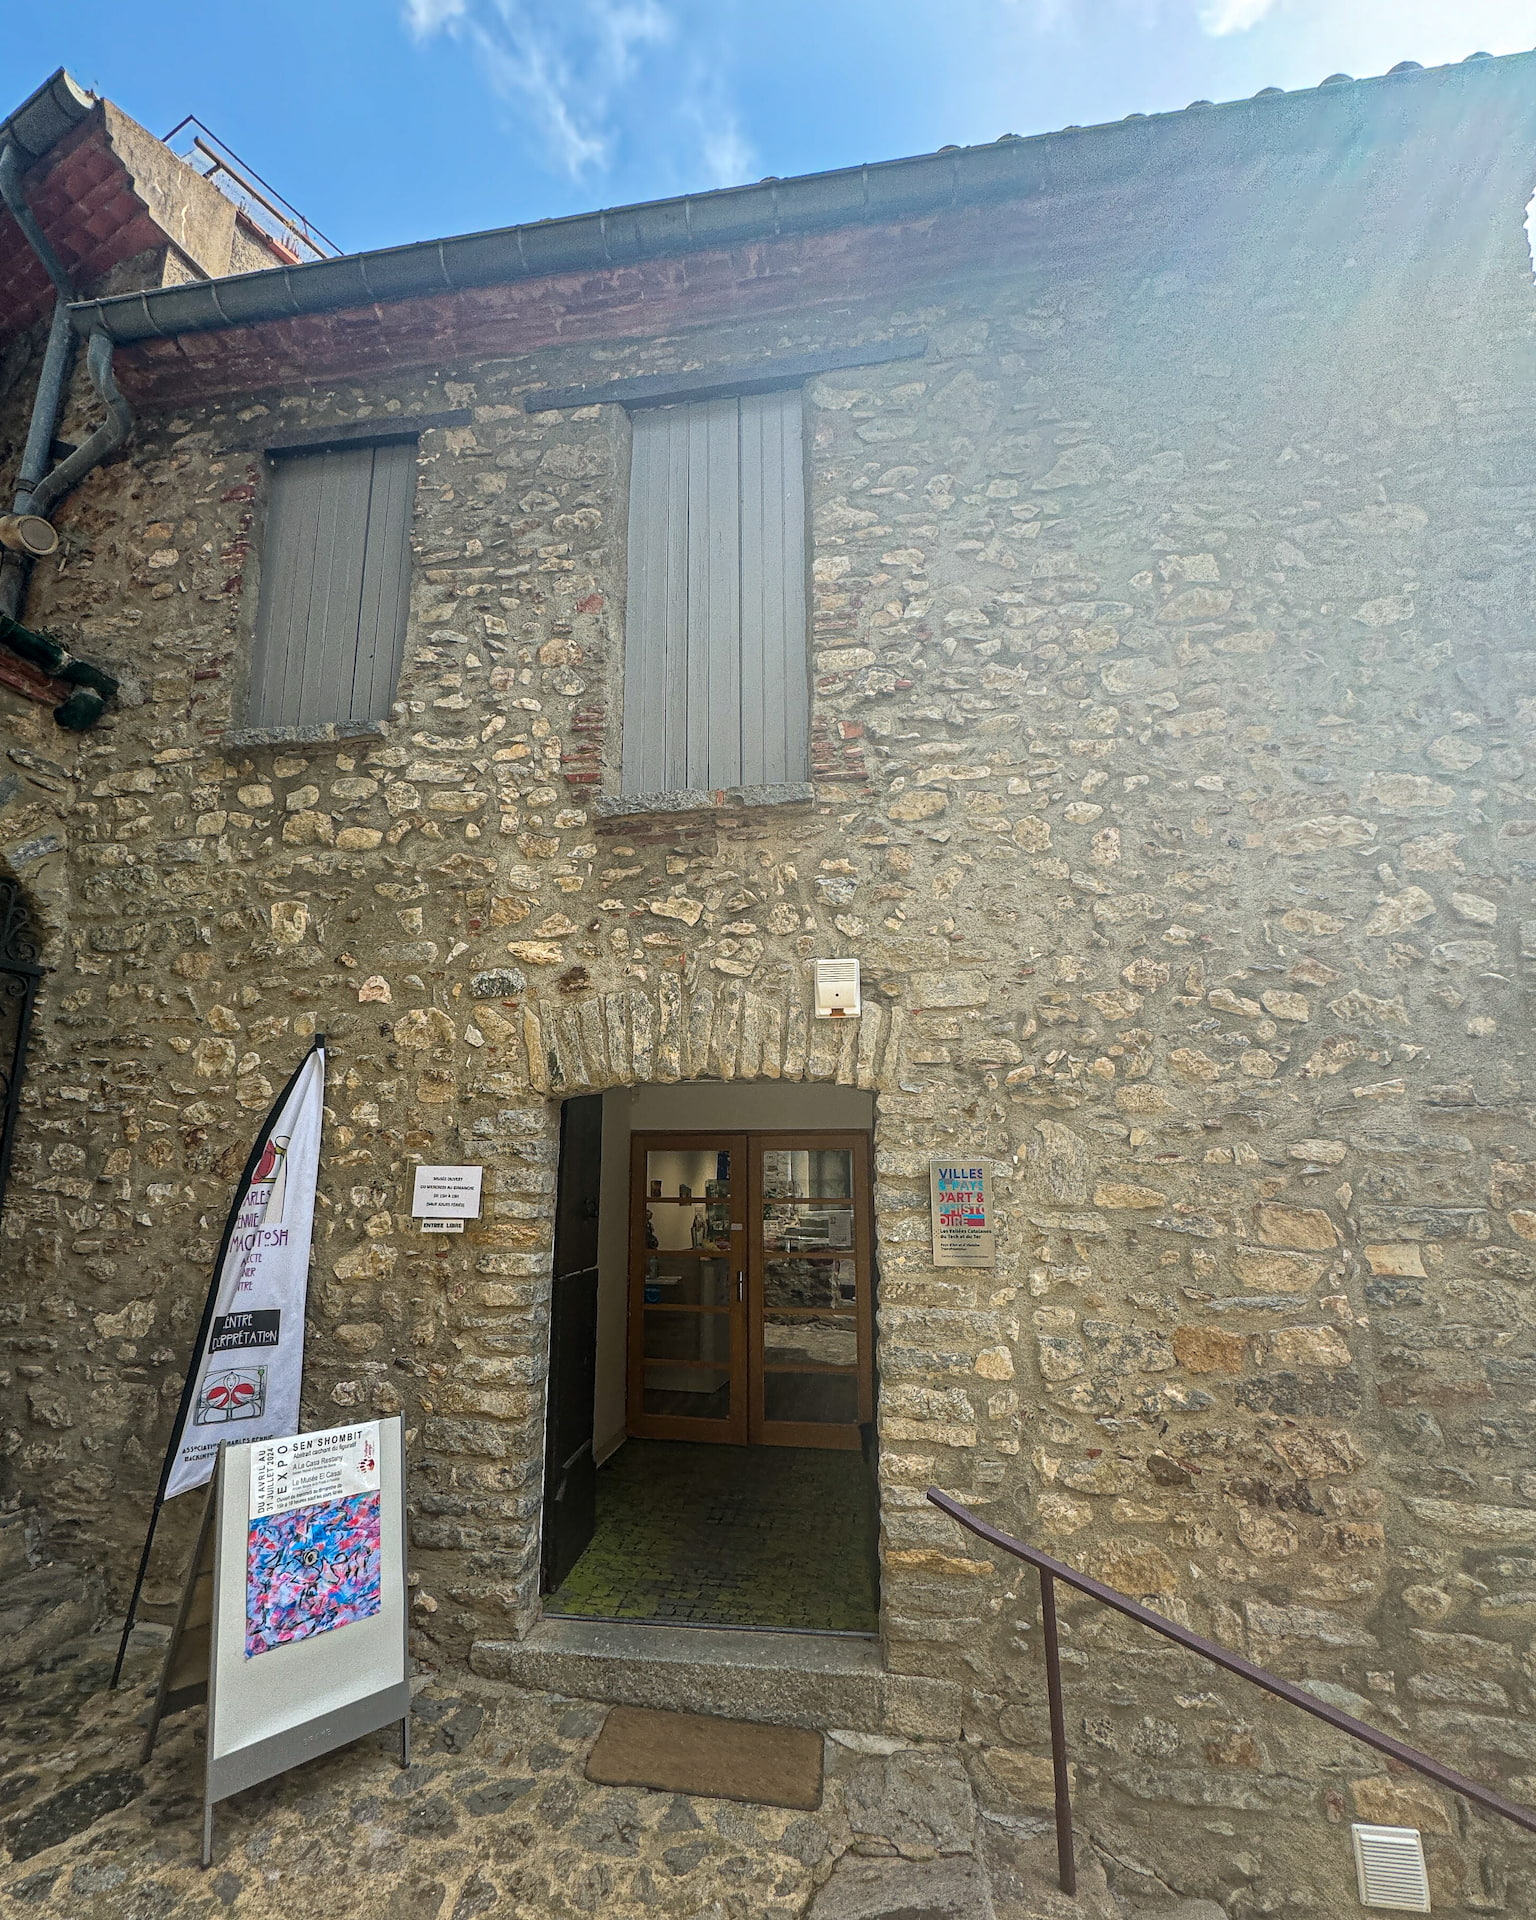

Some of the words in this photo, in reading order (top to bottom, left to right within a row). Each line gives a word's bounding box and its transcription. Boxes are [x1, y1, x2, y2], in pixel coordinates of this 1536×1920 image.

[938, 1168, 983, 1179] VILLES
[952, 1180, 984, 1191] PAYS
[939, 1192, 973, 1203] D'ART
[226, 1438, 250, 1447] HARLES
[293, 1440, 313, 1452] SEN
[317, 1430, 363, 1447] SHOMBIT
[293, 1450, 311, 1459] Abstrait
[339, 1441, 357, 1450] figuratif
[259, 1450, 266, 1462] AU
[305, 1459, 320, 1468] Casa
[277, 1445, 288, 1495] EXPO
[258, 1466, 266, 1492] AVRIL
[301, 1474, 318, 1484] Musée
[326, 1469, 342, 1478] Casal
[266, 1469, 274, 1500] JUILLET
[277, 1495, 290, 1503] Ouvert
[257, 1502, 265, 1513] DU
[266, 1502, 274, 1511] 31
